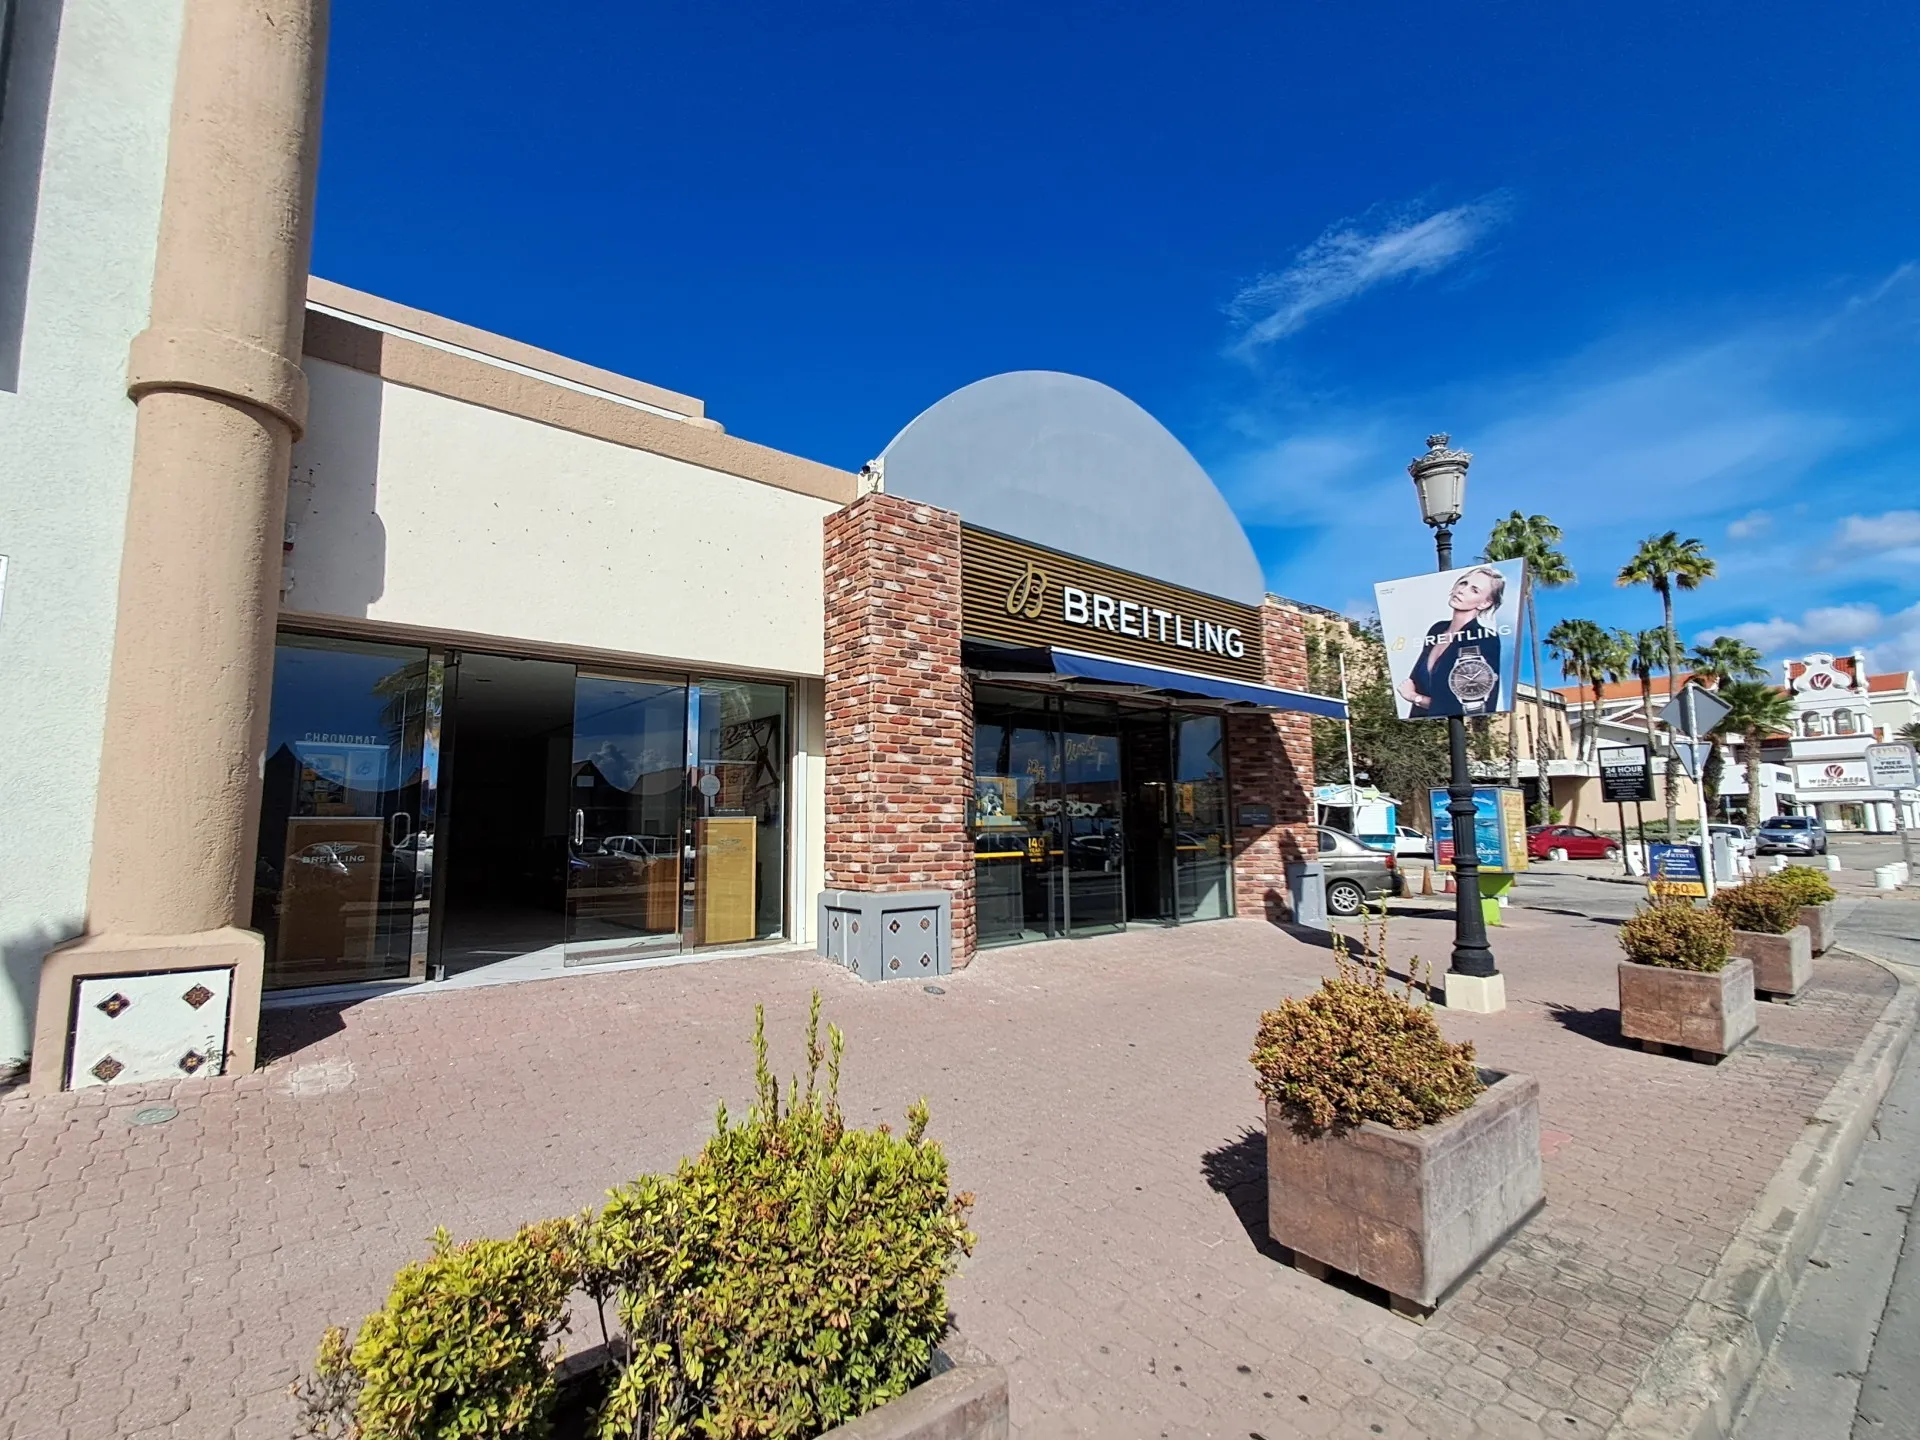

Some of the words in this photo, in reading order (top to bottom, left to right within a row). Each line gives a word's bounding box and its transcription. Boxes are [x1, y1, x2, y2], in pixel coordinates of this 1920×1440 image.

[1063, 585, 1245, 659] BREITLING
[1413, 624, 1512, 648] BREITLING
[305, 732, 377, 745] CHRONOMAT
[1028, 837, 1045, 848] 140
[301, 855, 365, 864] BREITLING
